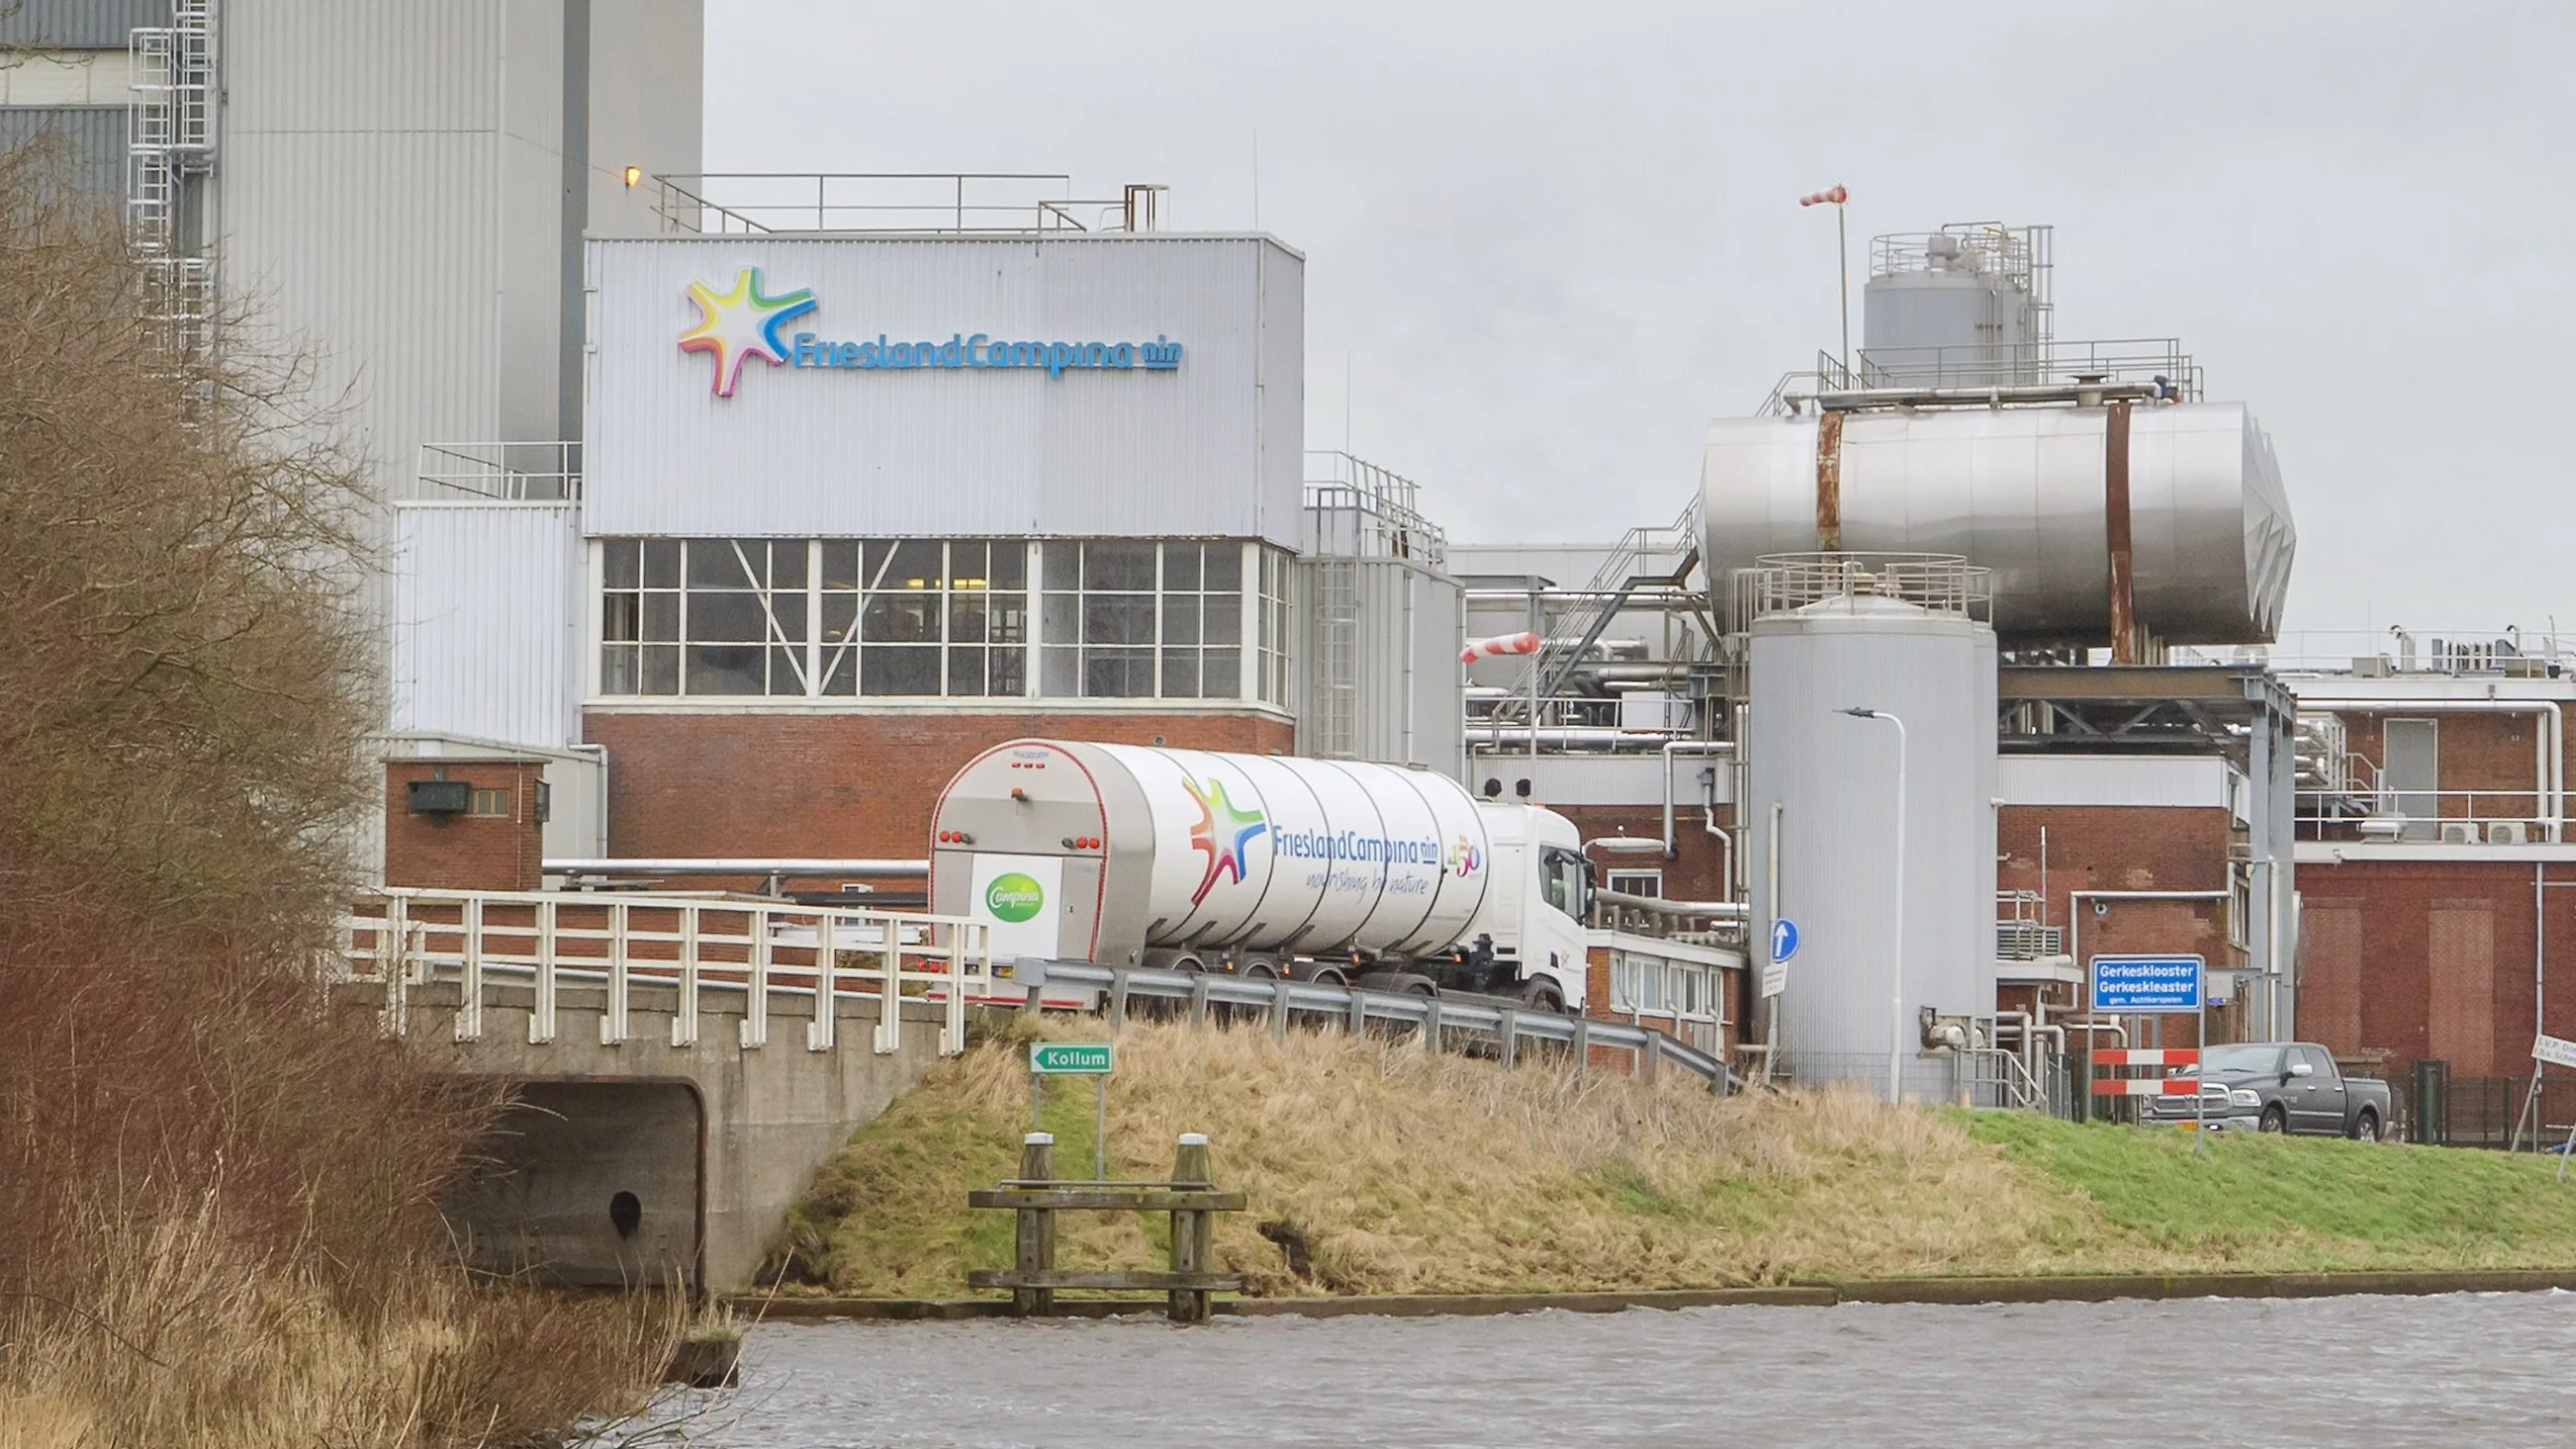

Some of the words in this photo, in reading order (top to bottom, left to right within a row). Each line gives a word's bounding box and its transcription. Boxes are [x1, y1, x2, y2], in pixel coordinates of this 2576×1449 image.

[793, 332, 1134, 380] FrieslandCampina
[1273, 825, 1418, 870] FrieslandCampina
[989, 886, 1039, 908] Campina
[1306, 867, 1368, 905] nourishing
[1389, 870, 1429, 894] nature
[2099, 965, 2194, 977] Gerkesklooster
[2099, 981, 2194, 993] Gerkeskleaster
[1049, 1051, 1105, 1065] Kollum
